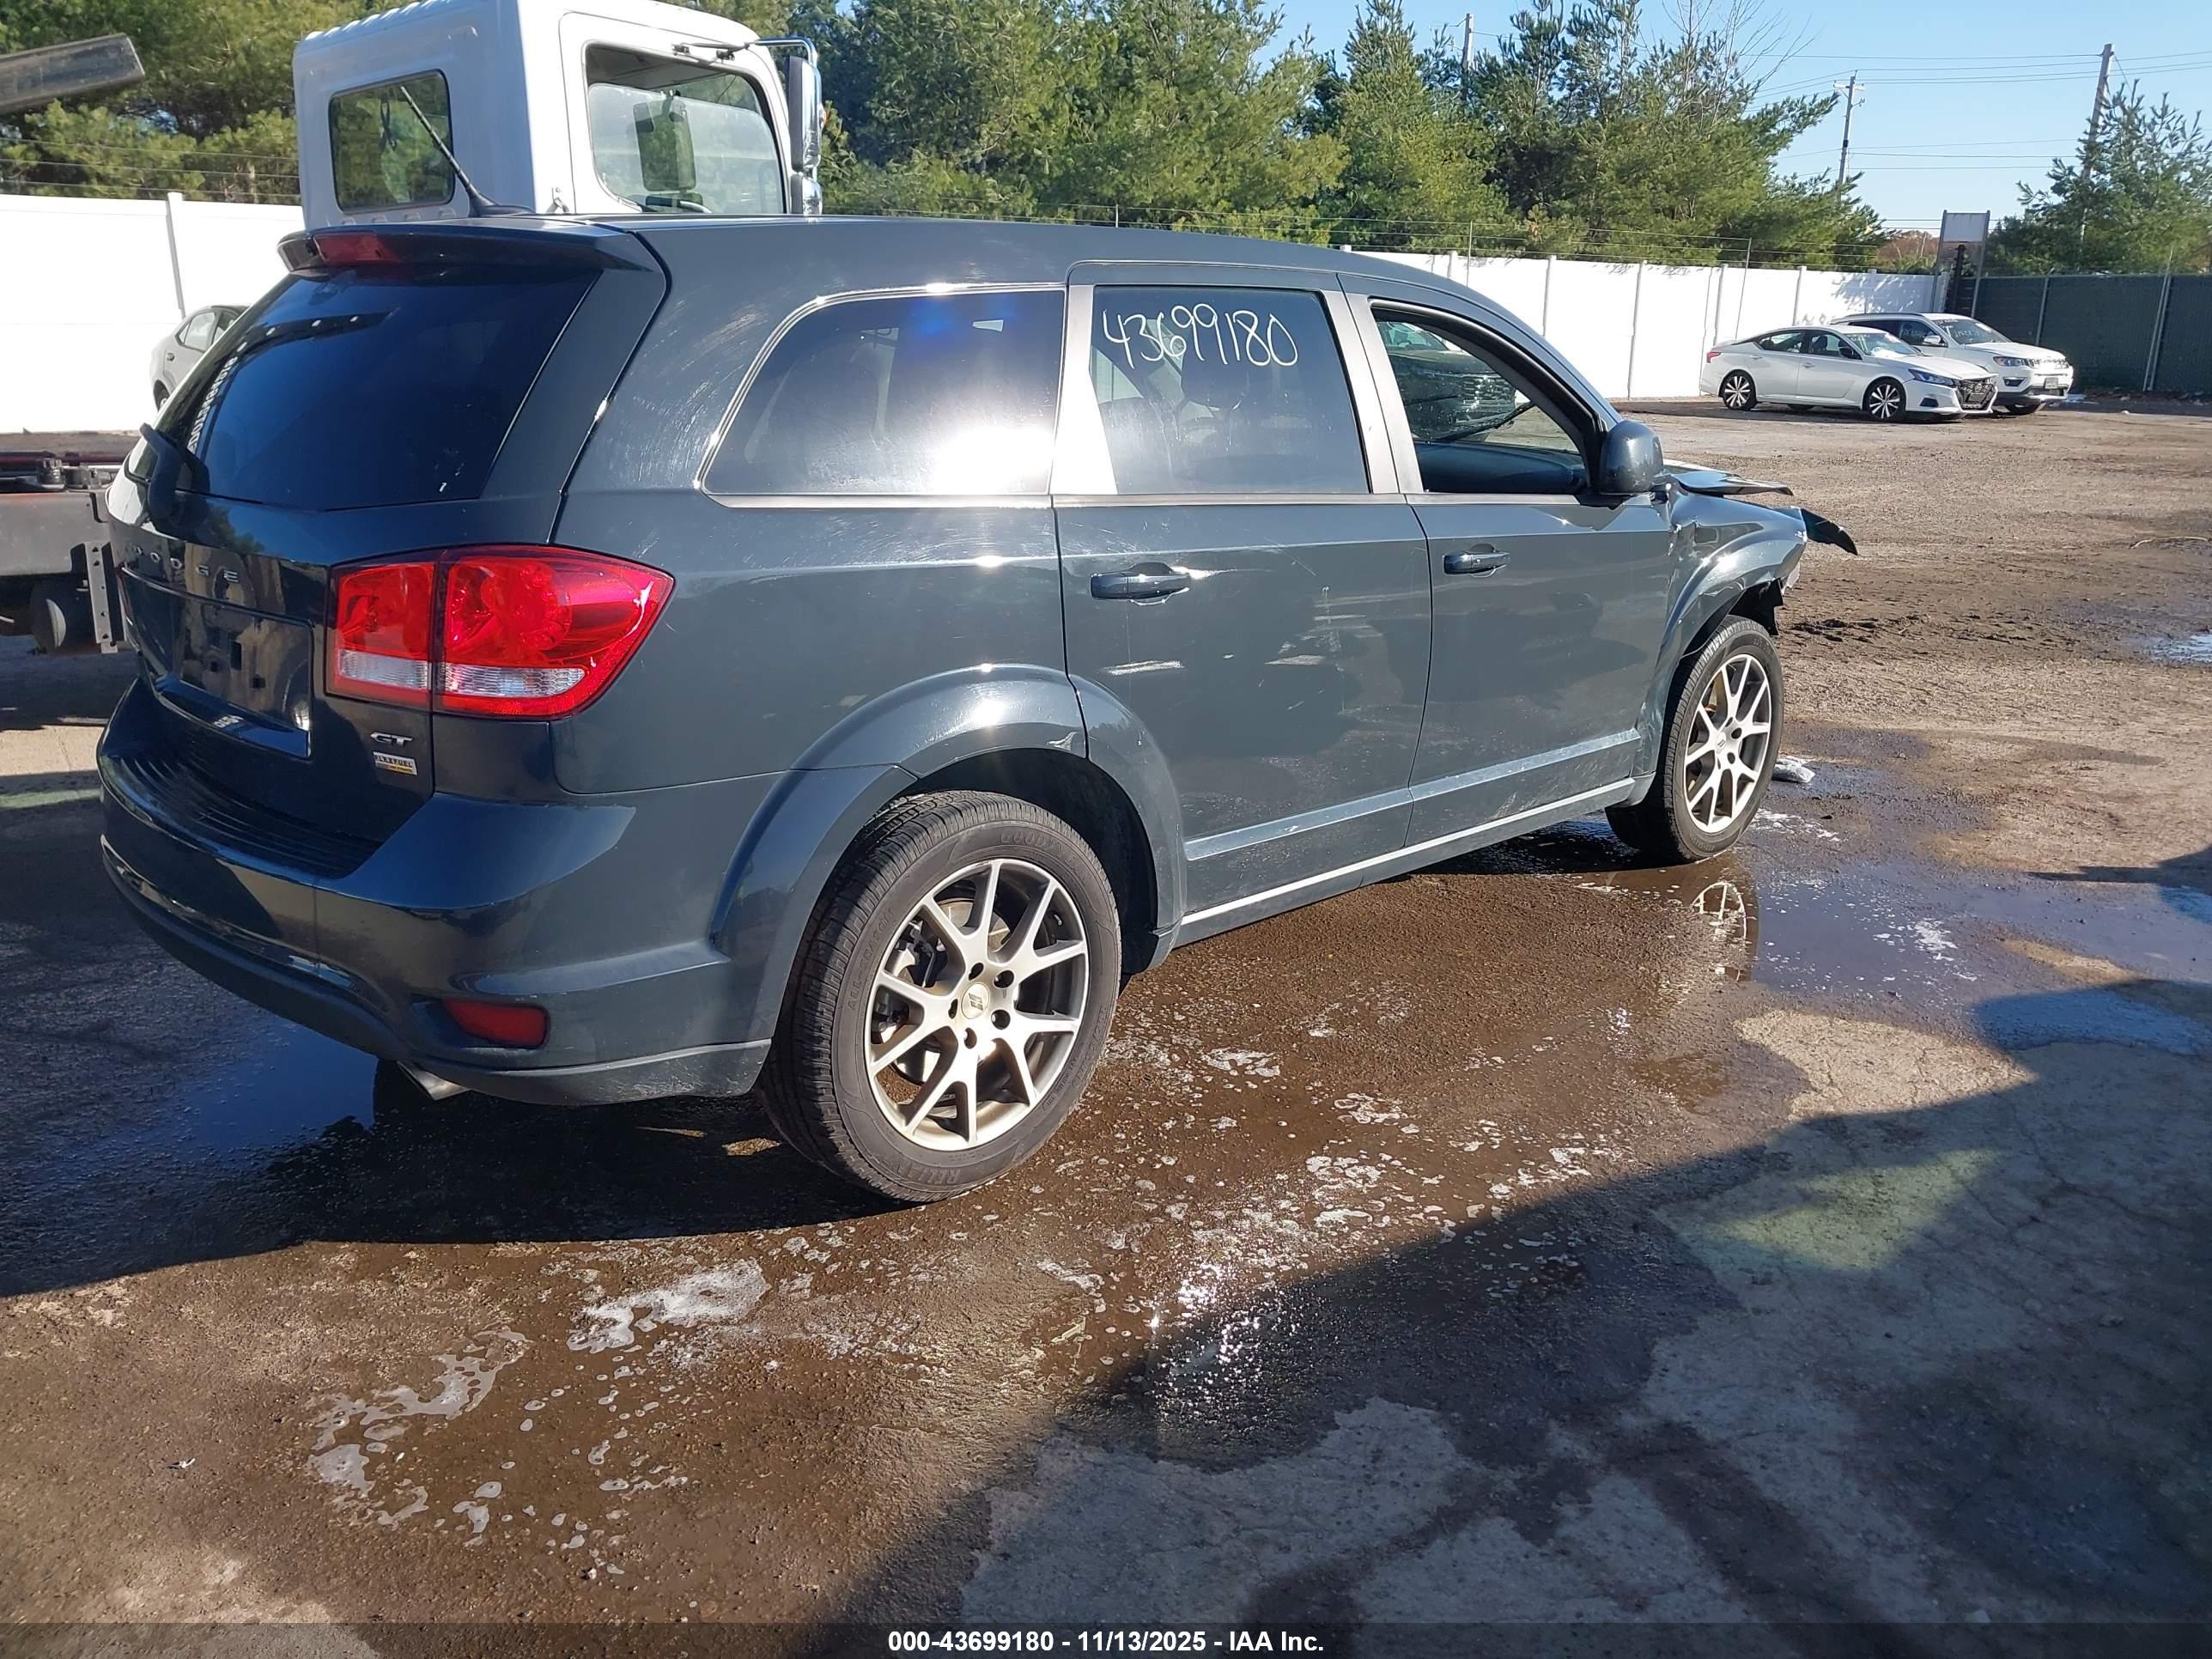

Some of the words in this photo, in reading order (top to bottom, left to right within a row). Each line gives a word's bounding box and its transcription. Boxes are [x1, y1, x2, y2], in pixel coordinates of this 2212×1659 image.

[1103, 303, 1297, 369] 43699180
[134, 545, 240, 583] DODGE
[370, 732, 413, 745] GT
